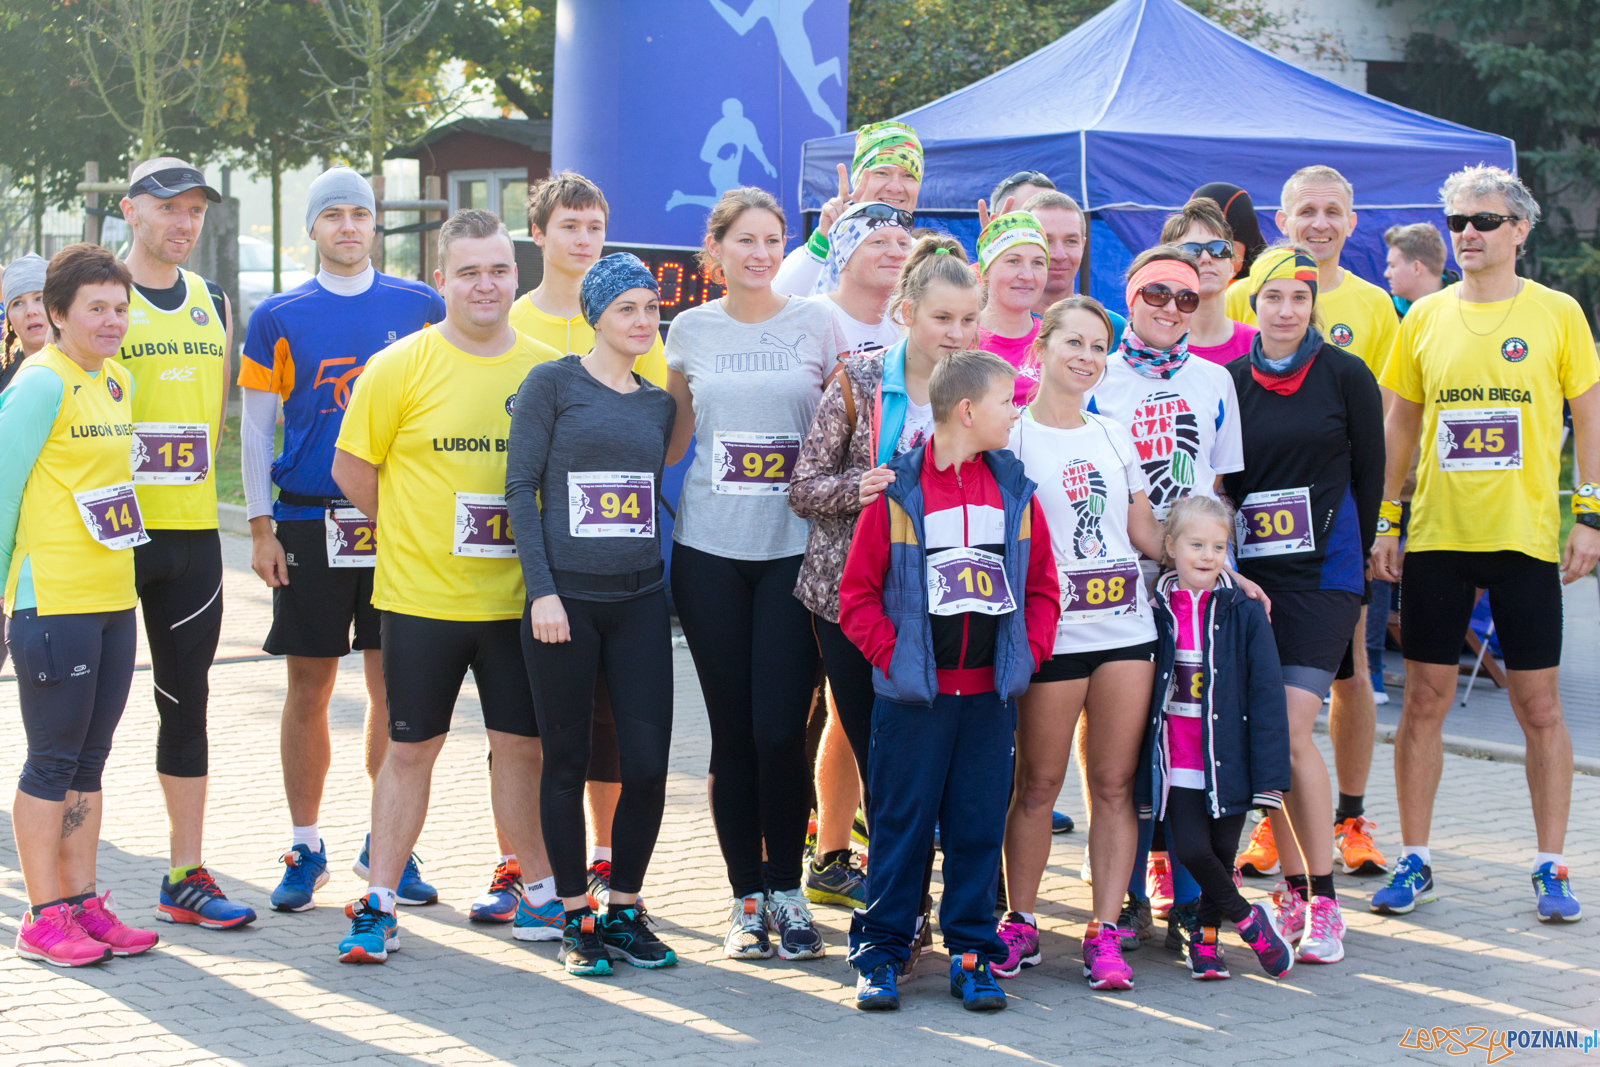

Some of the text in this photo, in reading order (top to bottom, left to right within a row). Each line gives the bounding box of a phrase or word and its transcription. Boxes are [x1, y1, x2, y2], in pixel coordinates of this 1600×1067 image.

[121, 339, 223, 360] LUBOŃ BIEGA
[716, 351, 790, 374] PUMA
[1488, 387, 1532, 404] BIEGA
[1133, 399, 1192, 421] ŚWIER
[71, 422, 113, 439] LUBOŃ
[1130, 415, 1174, 438] CZE
[432, 435, 491, 453] LUBOŃ
[1134, 436, 1174, 461] WO
[1463, 428, 1505, 452] 45
[158, 442, 195, 467] 15
[742, 452, 785, 478] 92
[1171, 450, 1195, 485] RUN
[1062, 474, 1089, 489] CZE
[1065, 485, 1089, 502] WO
[600, 492, 640, 518] 94
[105, 503, 133, 532] 14
[1253, 509, 1295, 538] 30
[957, 567, 993, 597] 10
[1086, 576, 1126, 605] 88
